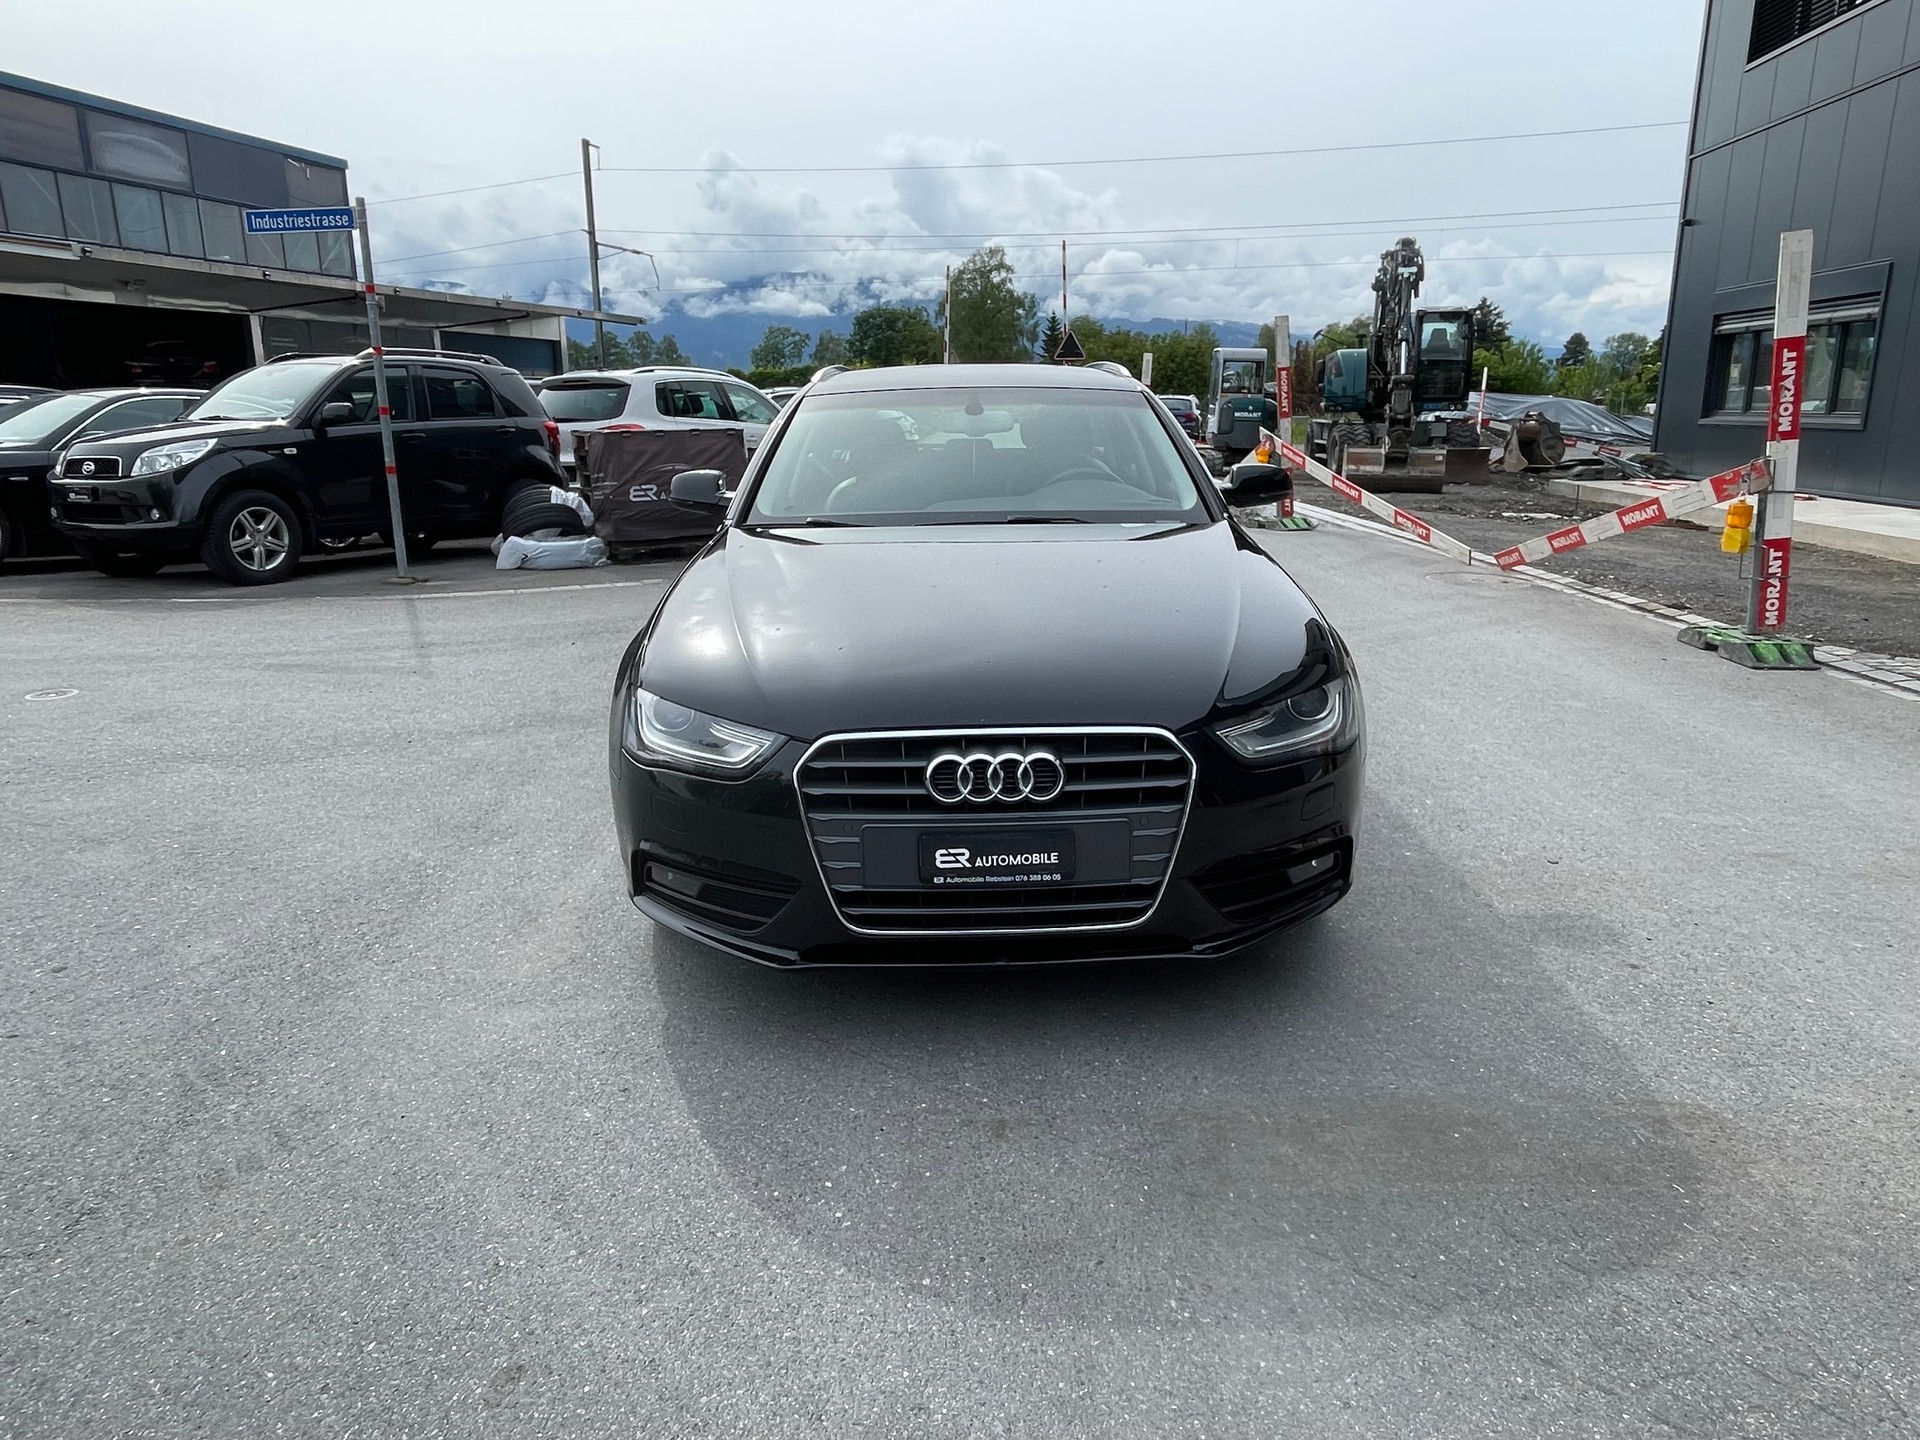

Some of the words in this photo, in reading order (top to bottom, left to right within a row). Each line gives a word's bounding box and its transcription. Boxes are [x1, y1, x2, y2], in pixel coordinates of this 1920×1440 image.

[250, 213, 349, 229] Industriestrasse
[1280, 370, 1289, 413] MORANT
[1777, 348, 1798, 432] MORANT
[1333, 477, 1360, 499] MORANT
[1396, 514, 1429, 537] MORANT
[1621, 504, 1660, 526] MORANT
[1551, 531, 1581, 549] MORANT
[1765, 548, 1783, 625] MORANT
[974, 852, 1059, 867] AUTOMOBILE
[1015, 874, 1028, 882] 076
[1042, 873, 1052, 882] 06
[1052, 873, 1061, 881] 05
